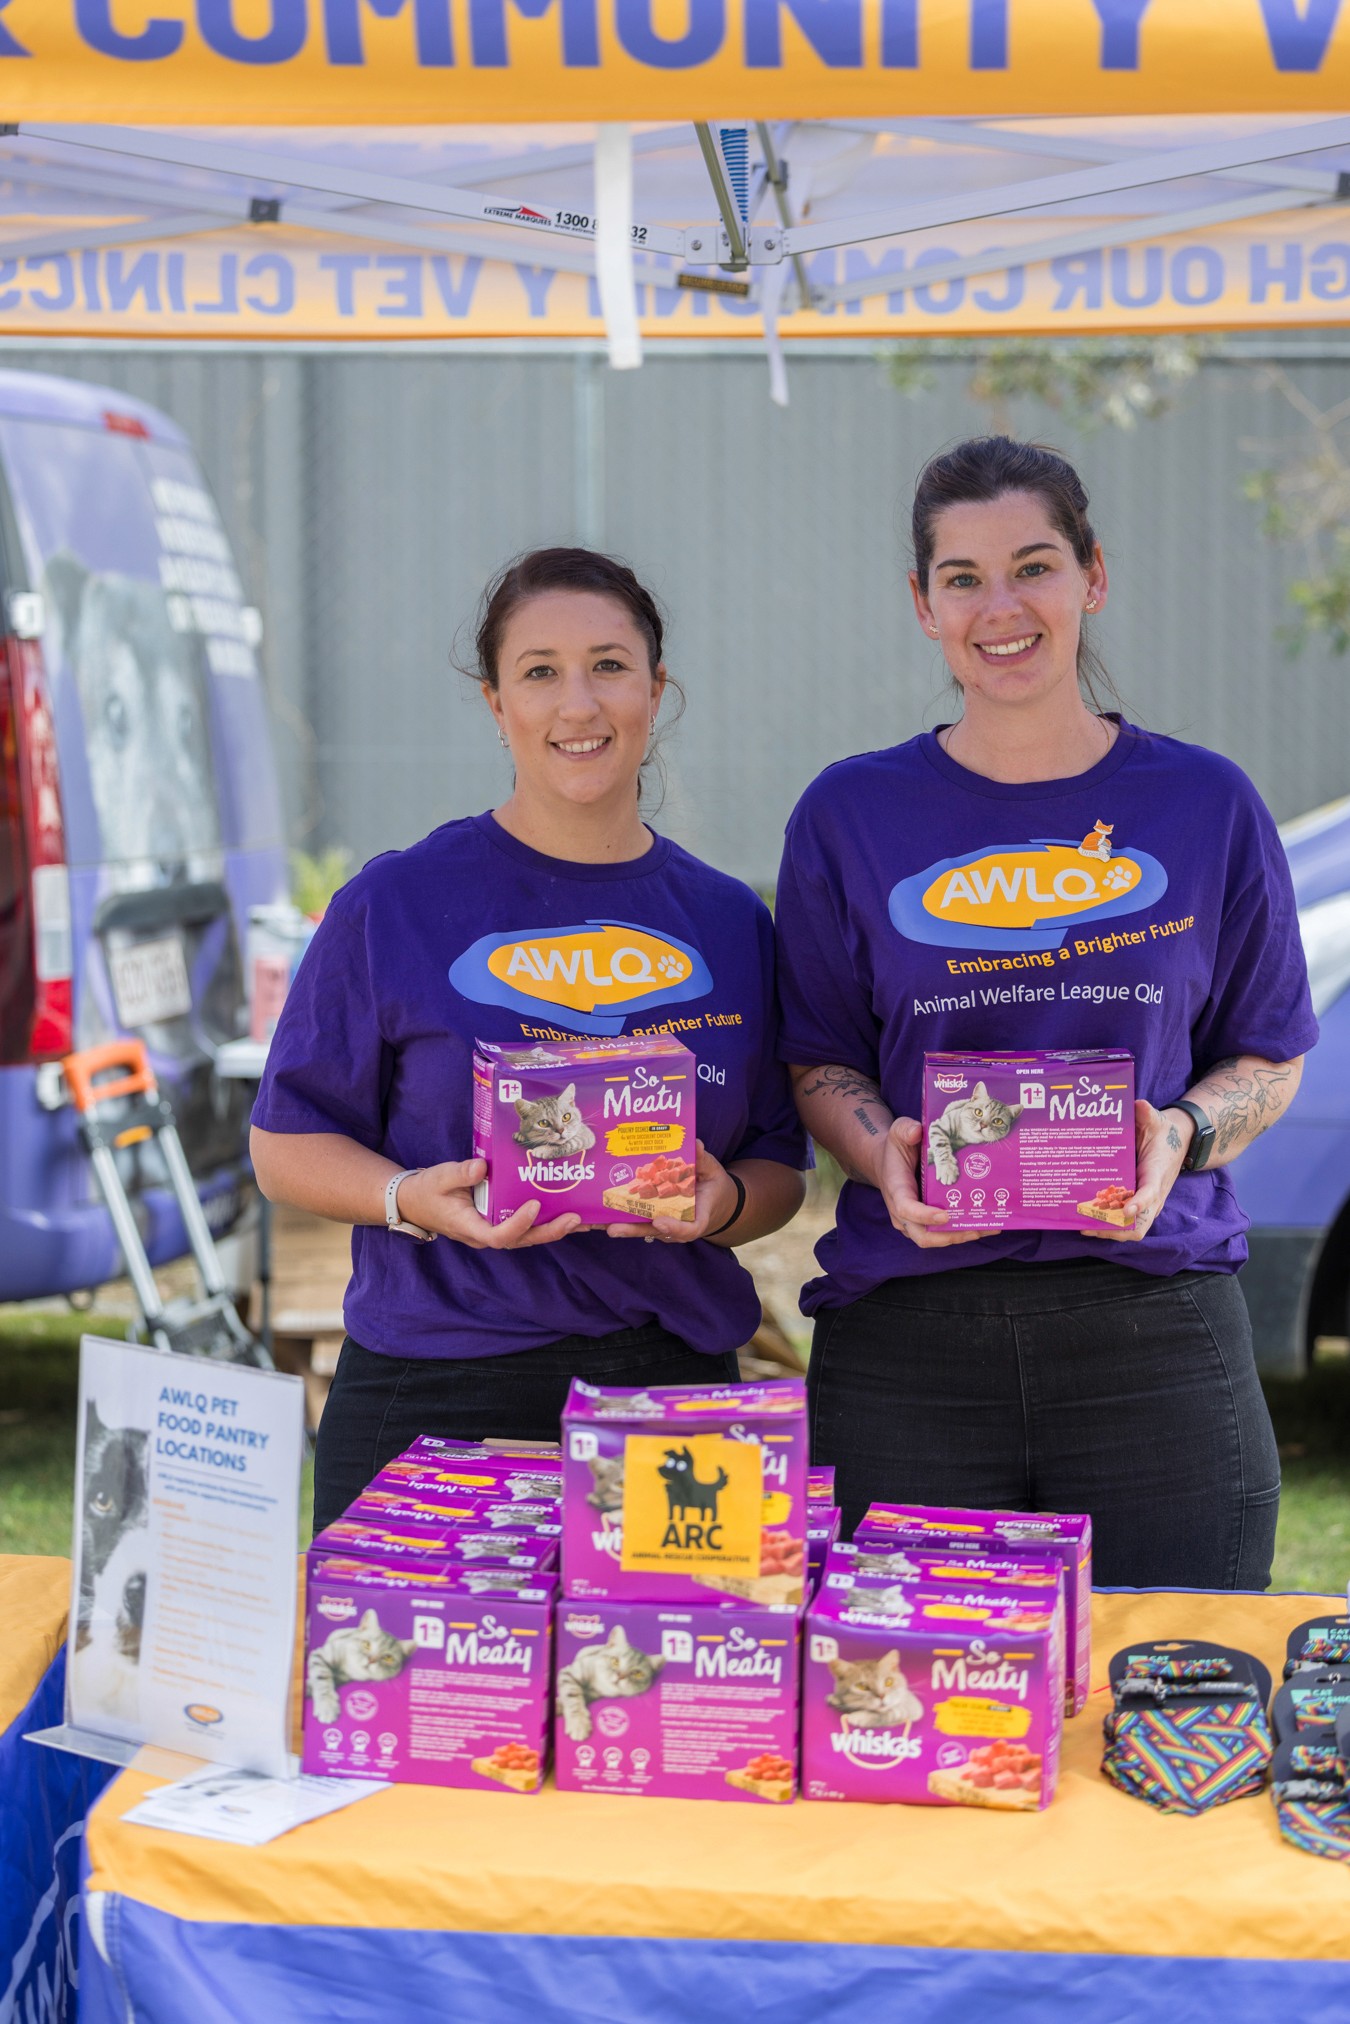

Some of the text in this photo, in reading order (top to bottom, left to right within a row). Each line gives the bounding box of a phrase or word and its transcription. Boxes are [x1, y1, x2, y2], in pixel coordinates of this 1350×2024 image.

[484, 207, 513, 219] EXTREME
[515, 214, 552, 227] MARQUEES
[555, 211, 588, 228] 1300
[940, 866, 1100, 909] AWLQ
[946, 913, 1195, 975] Embracing a Brighter Future
[506, 946, 656, 986] AWLQ
[913, 982, 1164, 1016] Animal Welfare League Qld
[704, 1012, 743, 1029] Future
[632, 1067, 659, 1089] So
[697, 1063, 725, 1086] Qld
[934, 1078, 968, 1089] whiskas
[1076, 1076, 1101, 1096] So
[603, 1085, 682, 1118] Meaty
[1049, 1093, 1122, 1122] Meaty
[518, 1161, 595, 1182] whiskas
[159, 1386, 238, 1416] AWLQ PET
[158, 1412, 269, 1449] FOOD PANTRY
[156, 1438, 247, 1472] LOCATIONS
[408, 1481, 458, 1493] Meaty
[509, 1472, 562, 1484] hiskas
[661, 1523, 723, 1550] ARC
[966, 1559, 1018, 1571] Meaty
[963, 1594, 1018, 1608] Meaty
[478, 1615, 509, 1640] So
[726, 1627, 758, 1652] So
[446, 1632, 532, 1673] Meaty
[695, 1644, 782, 1684] Meaty
[966, 1639, 1000, 1665] So
[931, 1658, 1028, 1700] Meaty
[830, 1729, 922, 1759] whiskas
